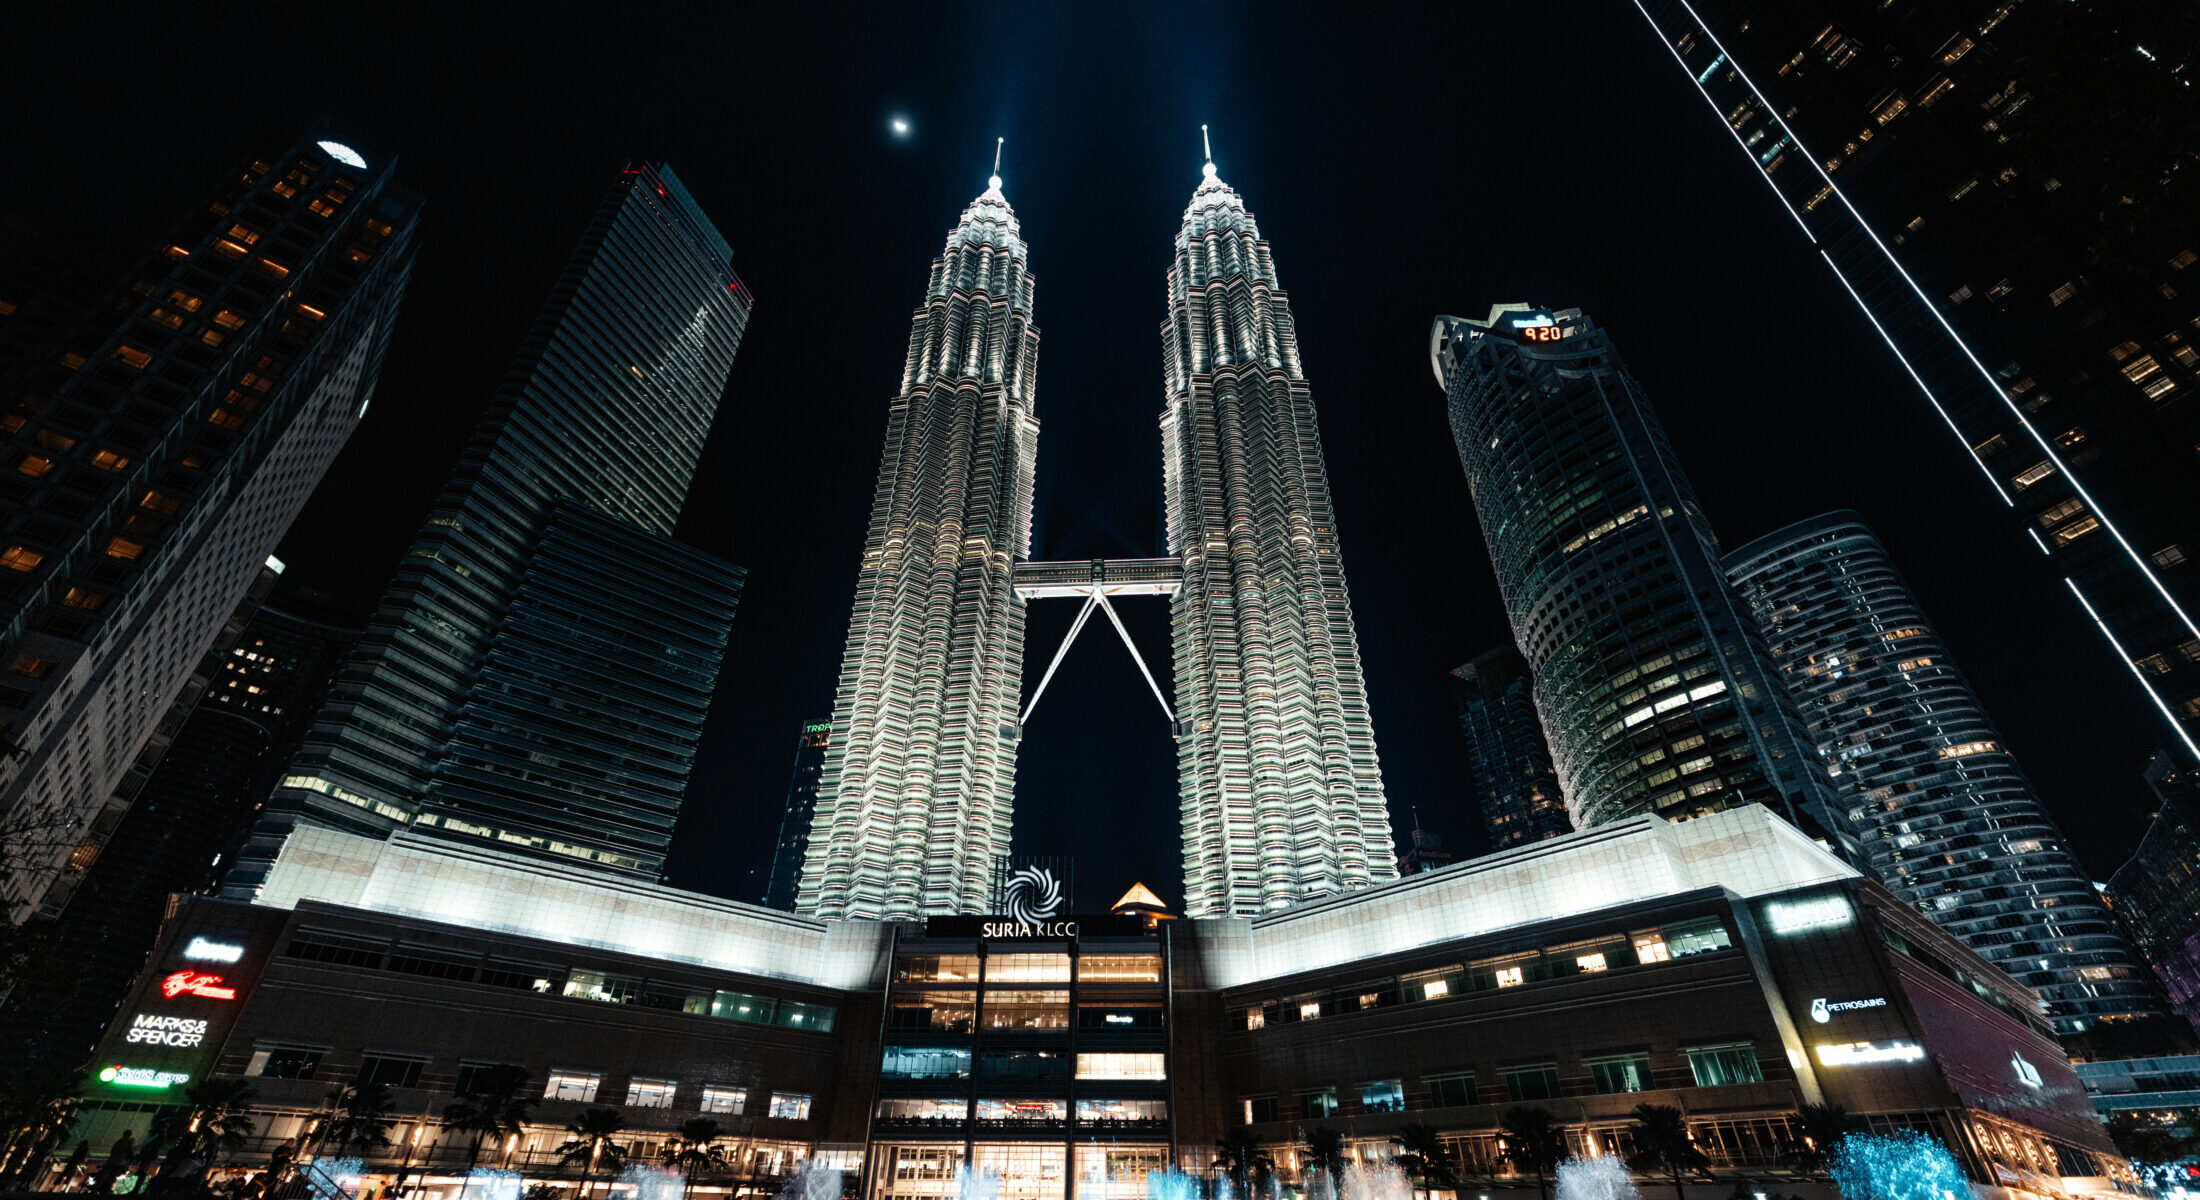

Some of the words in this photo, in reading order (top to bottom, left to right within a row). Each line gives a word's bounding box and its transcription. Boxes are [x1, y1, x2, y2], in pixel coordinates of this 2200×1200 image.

[982, 922, 1032, 938] SURIA
[1036, 922, 1076, 937] KLCC
[1826, 998, 1887, 1012] PETROSAINS
[126, 1028, 202, 1048] SPENCER
[144, 1069, 190, 1084] Sorage
